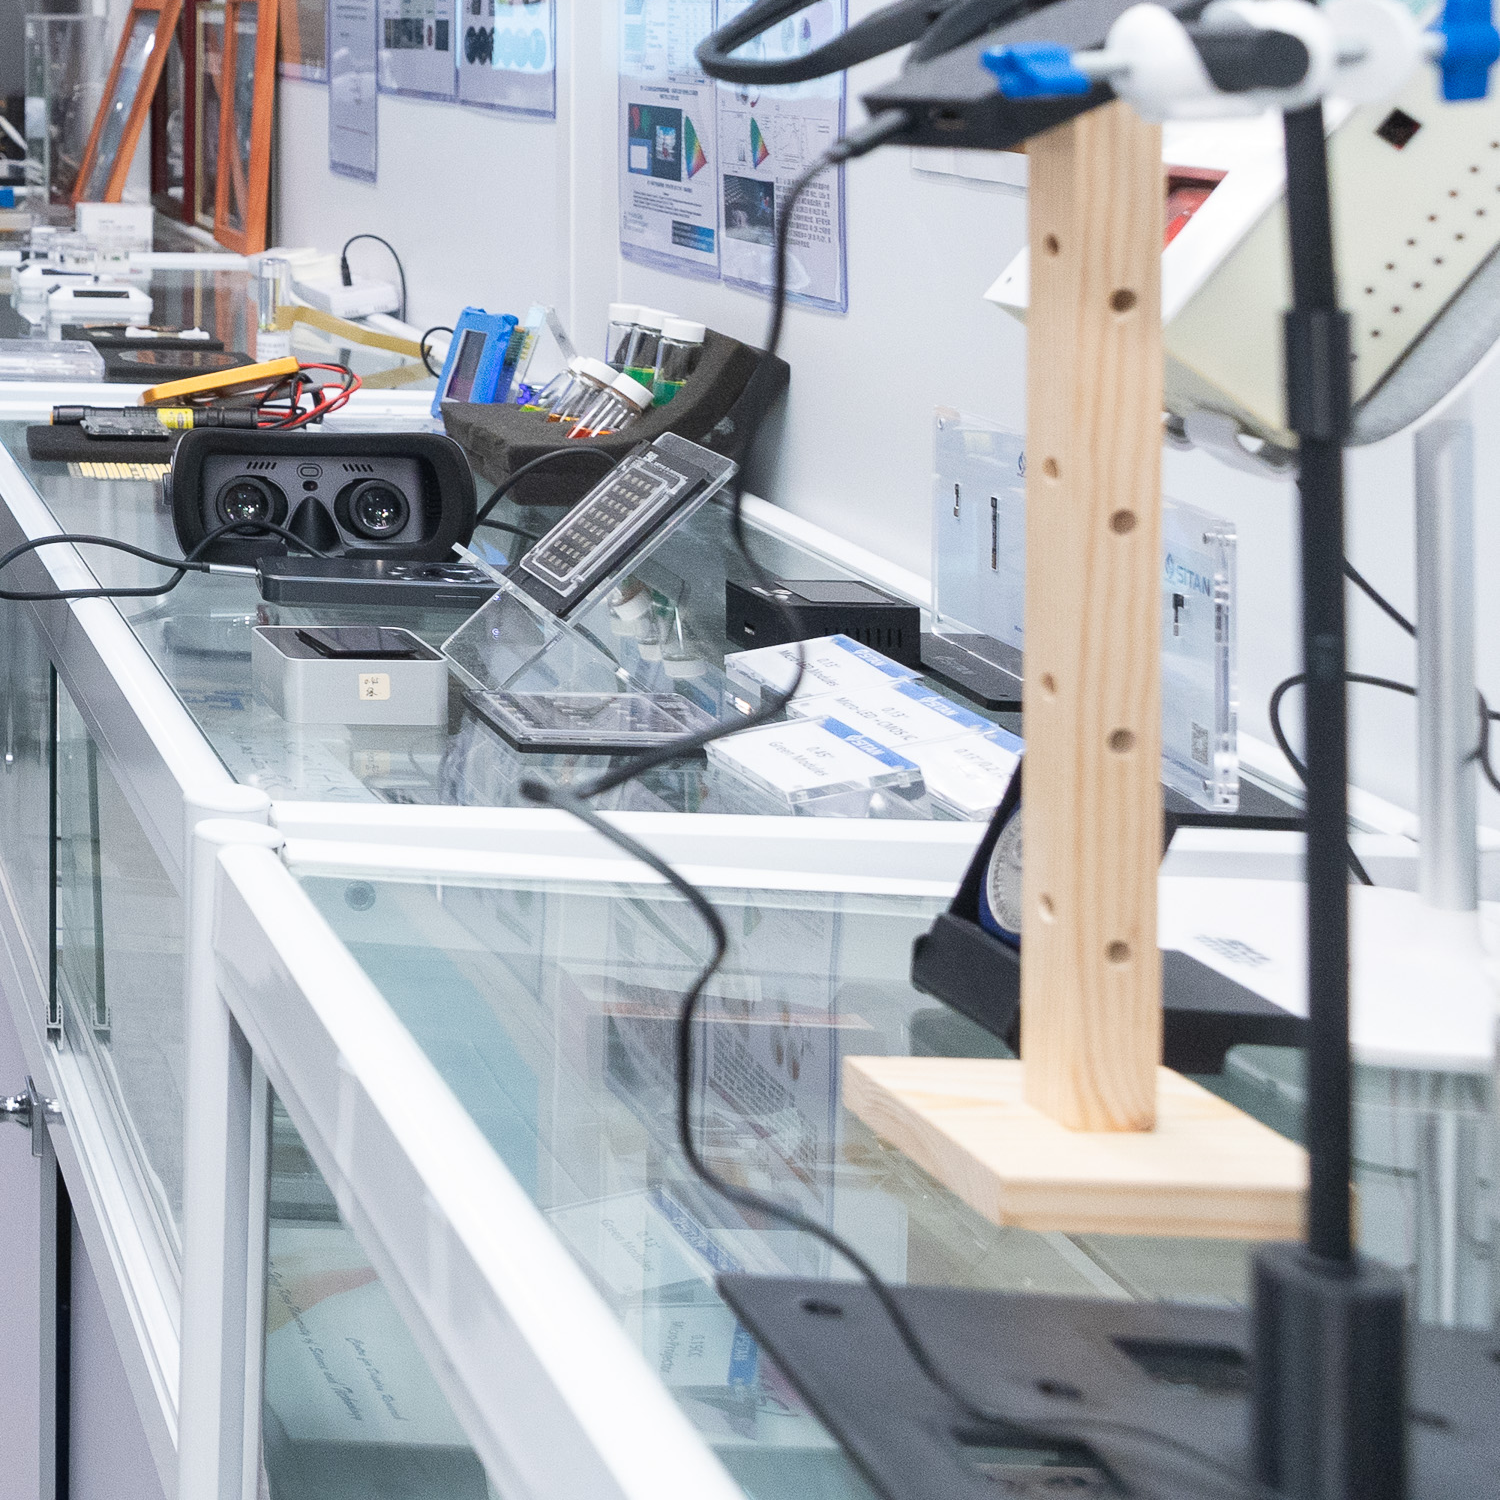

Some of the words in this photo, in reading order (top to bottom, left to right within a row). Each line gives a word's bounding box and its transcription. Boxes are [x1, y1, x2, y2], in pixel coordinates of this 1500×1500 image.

[1176, 564, 1211, 598] SITAN
[834, 696, 878, 720] Micro-LED
[768, 740, 795, 756] Green
[792, 753, 830, 777] Modules
[854, 736, 886, 756] SITAN
[600, 1217, 627, 1243] Green
